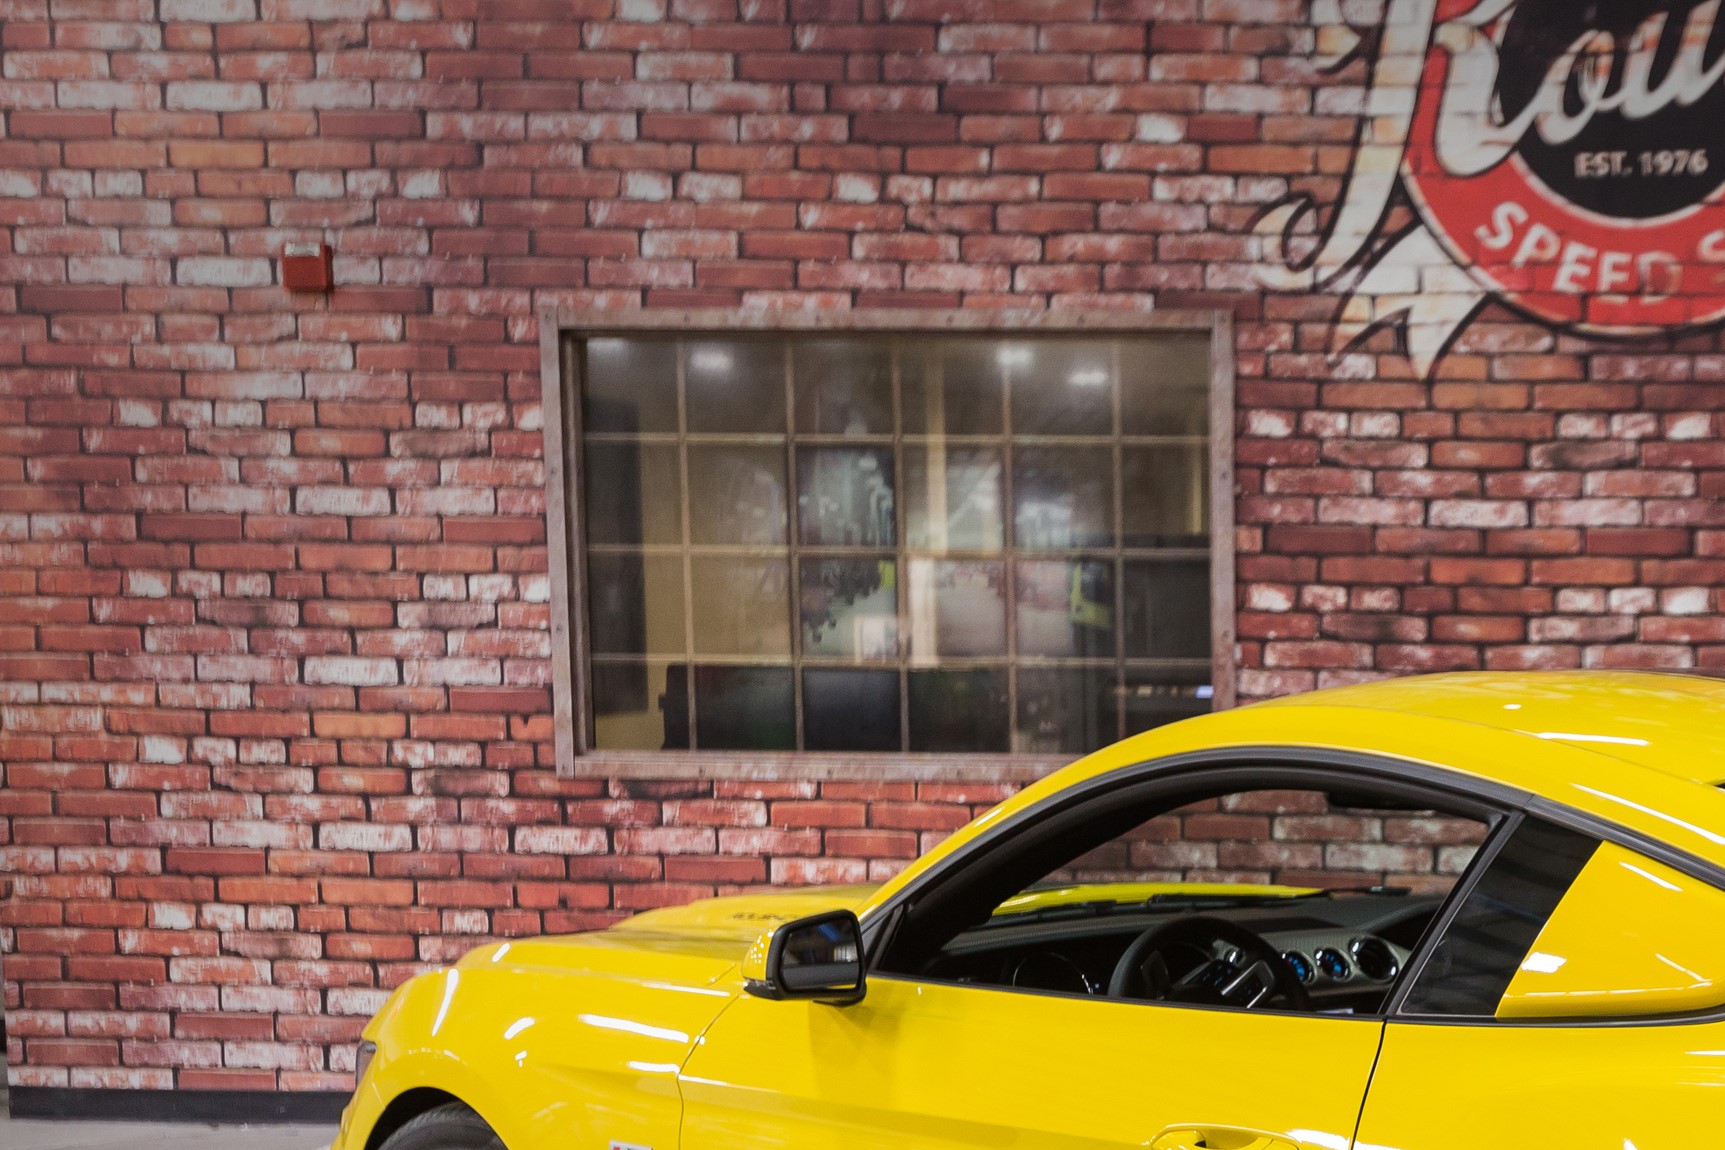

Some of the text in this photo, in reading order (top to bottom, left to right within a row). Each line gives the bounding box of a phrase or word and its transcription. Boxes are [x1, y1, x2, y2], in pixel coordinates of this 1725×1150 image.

[1573, 149, 1709, 177] EST. 1976
[1474, 201, 1684, 305] SPEED
